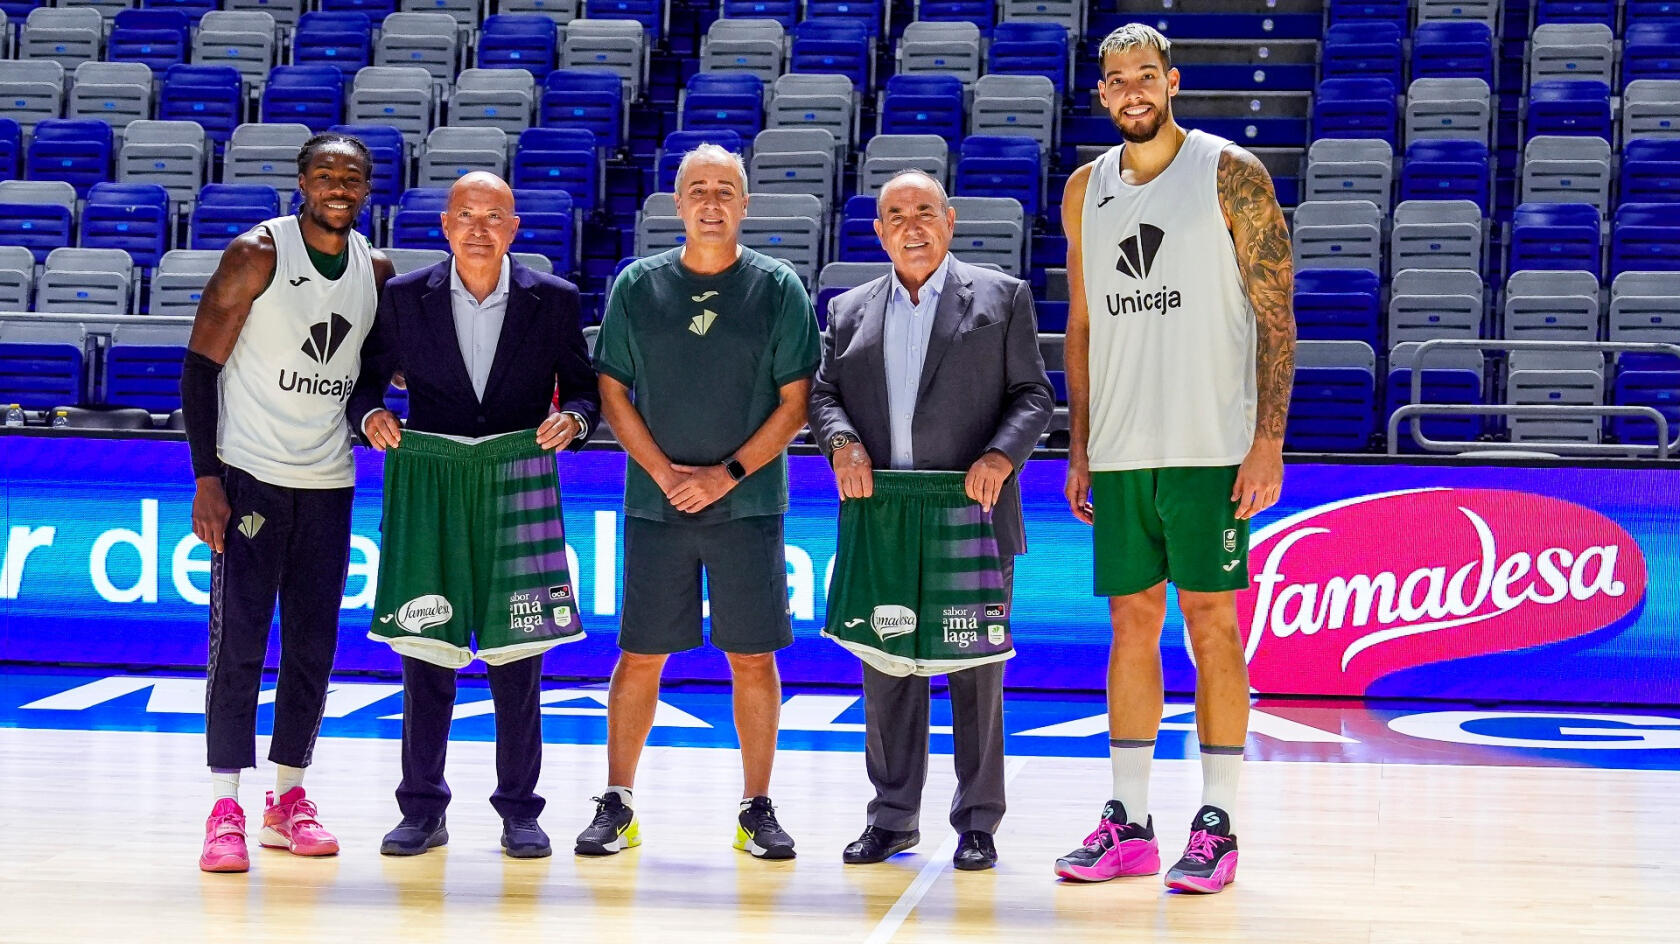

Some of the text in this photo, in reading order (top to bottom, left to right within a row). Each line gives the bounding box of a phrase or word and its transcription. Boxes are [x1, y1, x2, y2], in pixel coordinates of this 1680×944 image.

[1106, 285, 1181, 316] Unicaja
[551, 590, 566, 598] acb
[1244, 506, 1626, 672] famadesa
[943, 606, 968, 615] sabor
[986, 608, 1001, 616] acb
[510, 613, 543, 632] laga
[949, 611, 978, 629] má
[944, 626, 978, 648] laga
